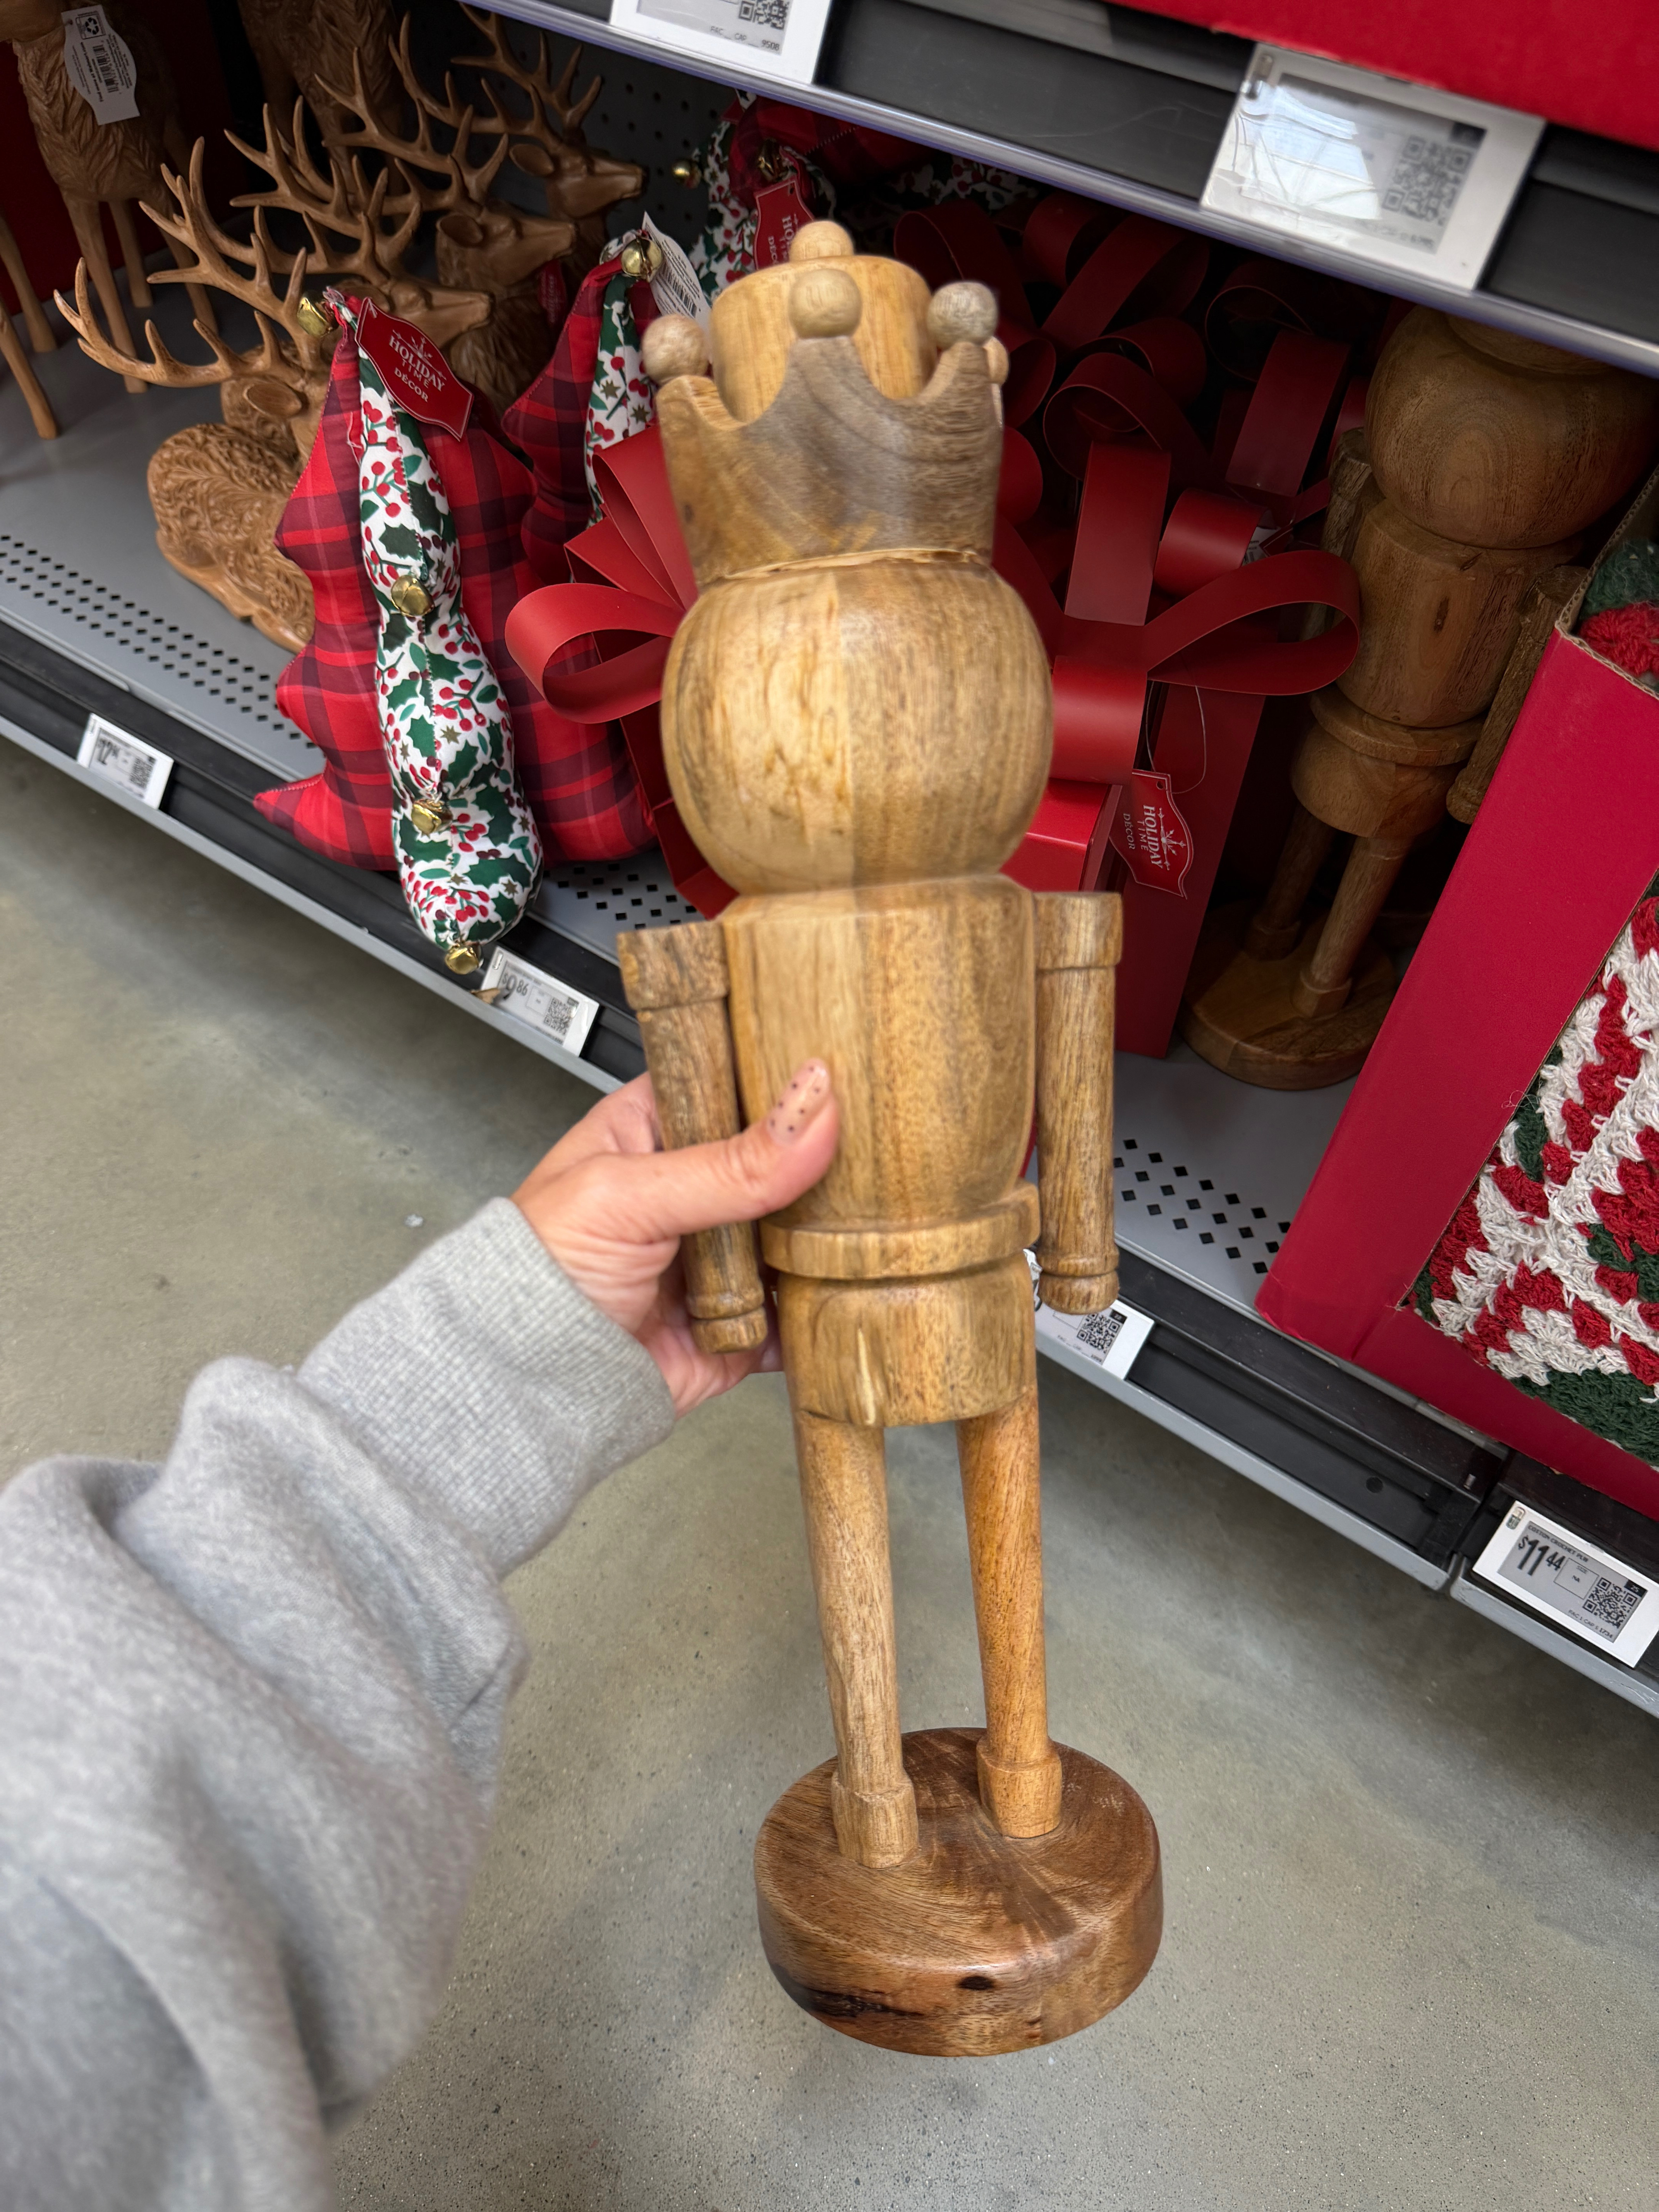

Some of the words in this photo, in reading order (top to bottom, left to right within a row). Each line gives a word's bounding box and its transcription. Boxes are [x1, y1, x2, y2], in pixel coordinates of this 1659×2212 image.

[389, 335, 445, 392] HOLIDAY
[402, 358, 430, 388] TIME
[1123, 813, 1135, 850] DÉCOR
[1137, 821, 1149, 851] TIME
[1143, 804, 1163, 869] HOLIDAY
